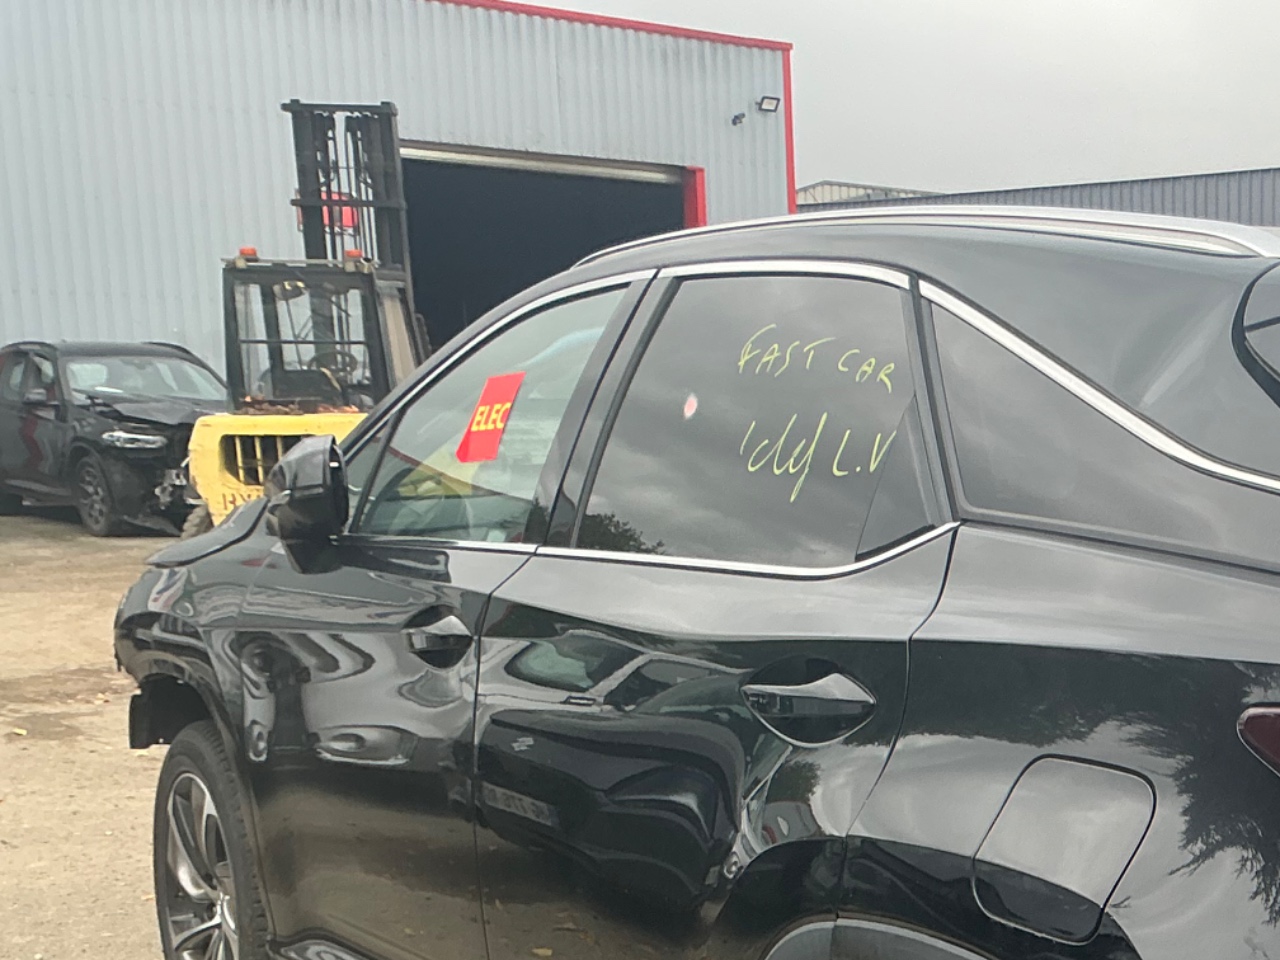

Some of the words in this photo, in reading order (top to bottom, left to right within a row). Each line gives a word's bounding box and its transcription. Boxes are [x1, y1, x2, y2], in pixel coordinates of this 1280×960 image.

[738, 323, 836, 377] FAST
[837, 348, 895, 394] CAR
[470, 402, 512, 432] ELEC
